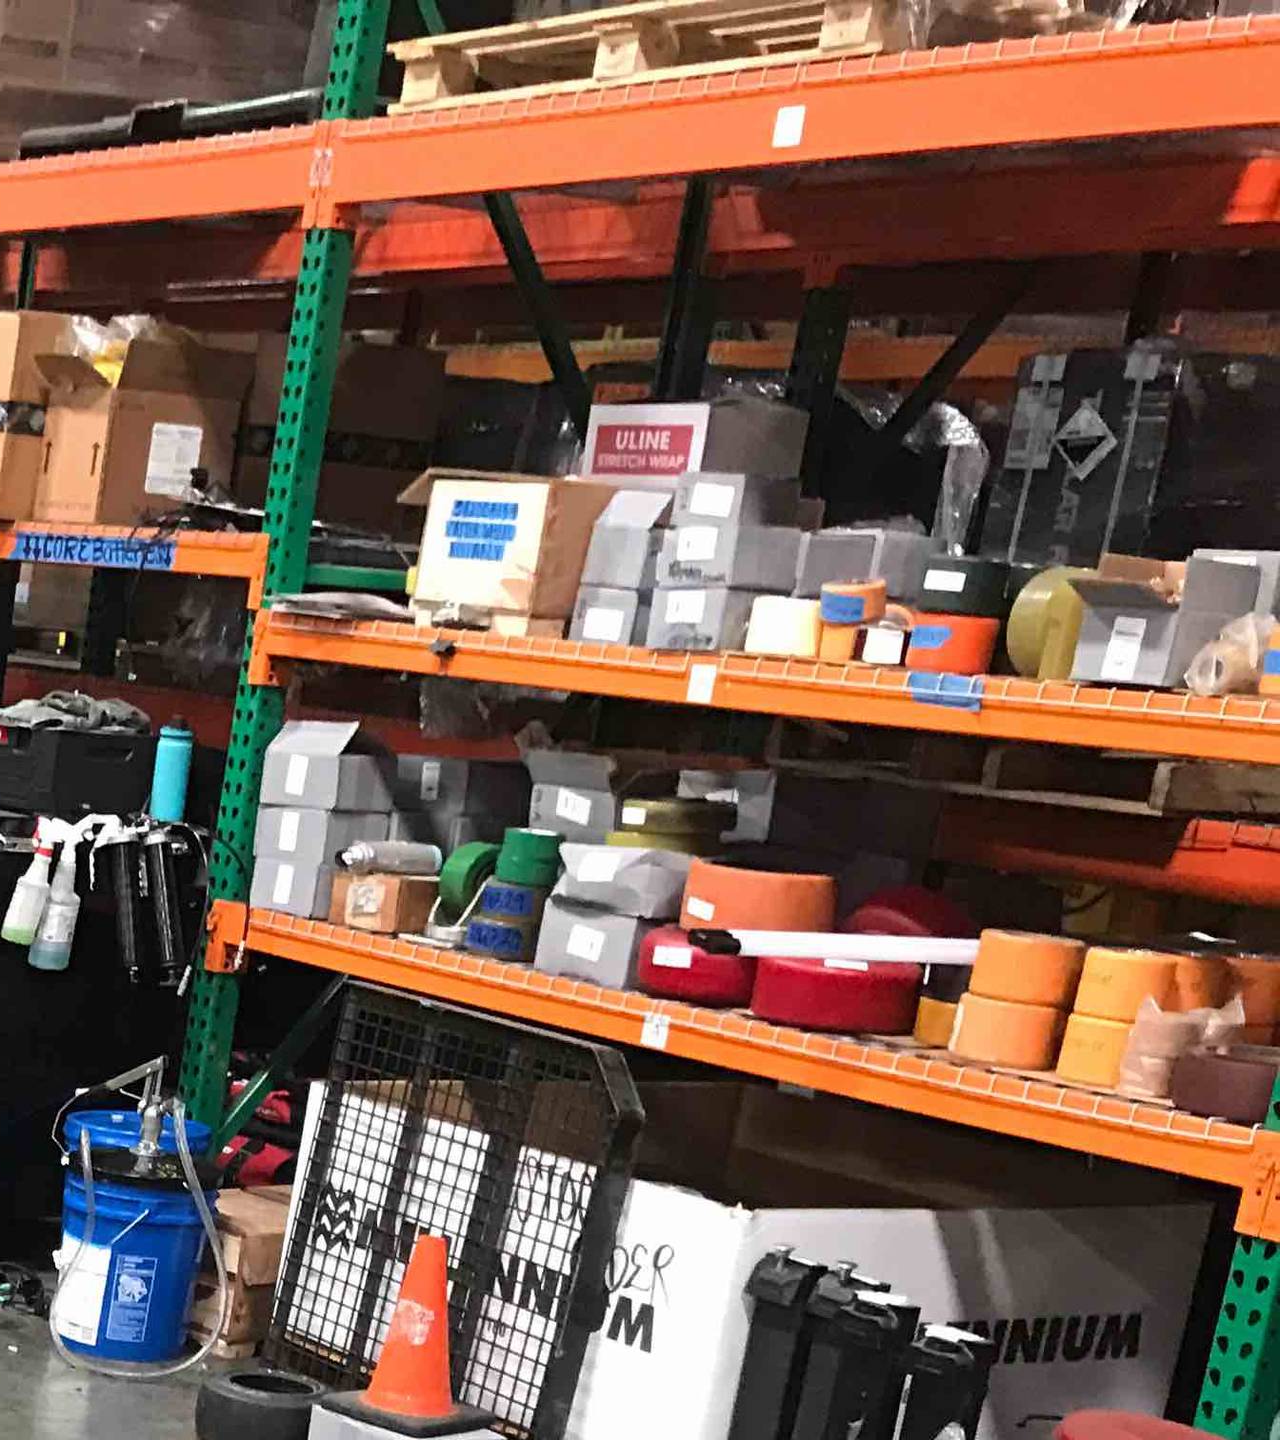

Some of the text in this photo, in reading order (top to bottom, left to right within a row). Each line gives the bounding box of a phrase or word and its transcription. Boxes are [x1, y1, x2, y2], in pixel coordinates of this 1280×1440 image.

[615, 429, 672, 451] ULINE
[597, 452, 686, 470] STRETCH WRAP
